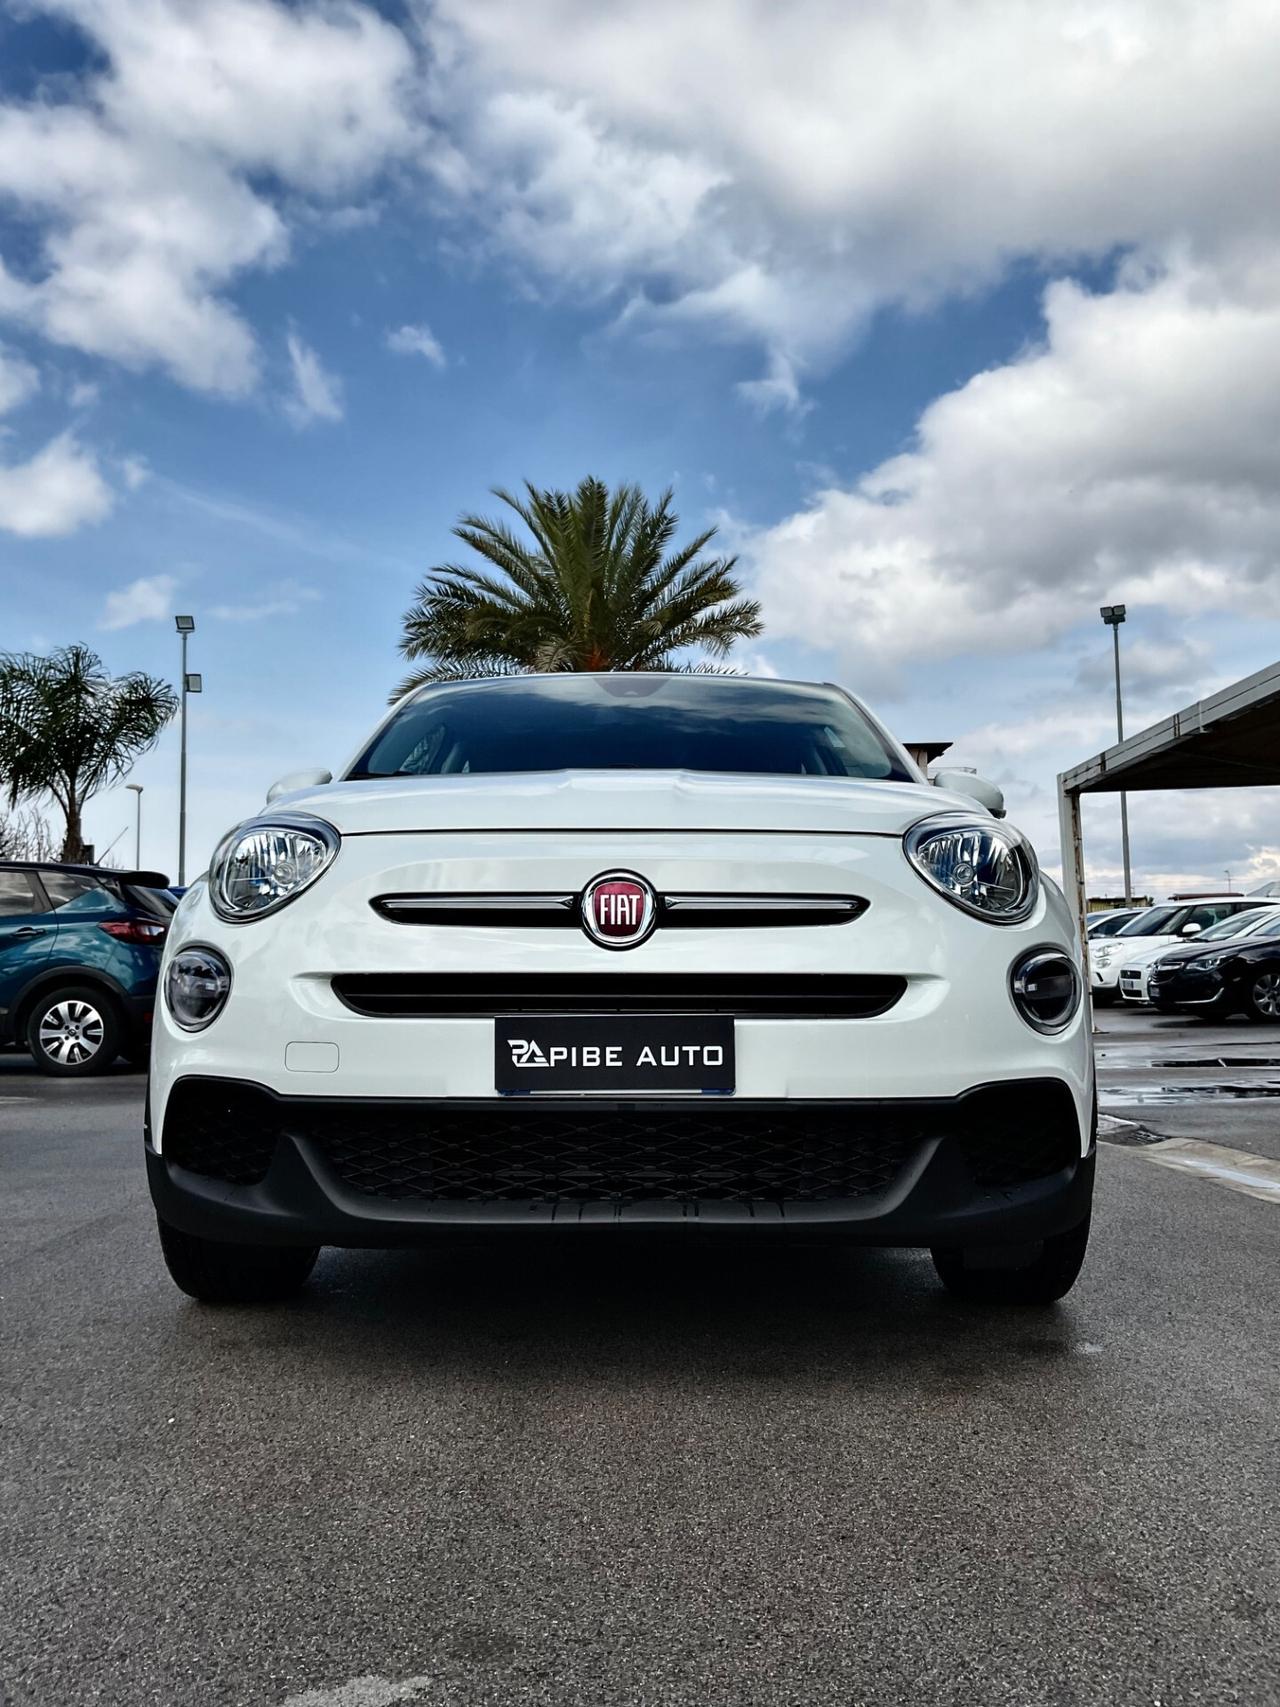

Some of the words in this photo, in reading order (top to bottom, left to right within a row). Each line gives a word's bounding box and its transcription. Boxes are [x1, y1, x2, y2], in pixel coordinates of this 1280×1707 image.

[600, 894, 640, 925] FIAT
[550, 1046, 623, 1067] PIBE
[636, 1046, 723, 1066] AUTO
